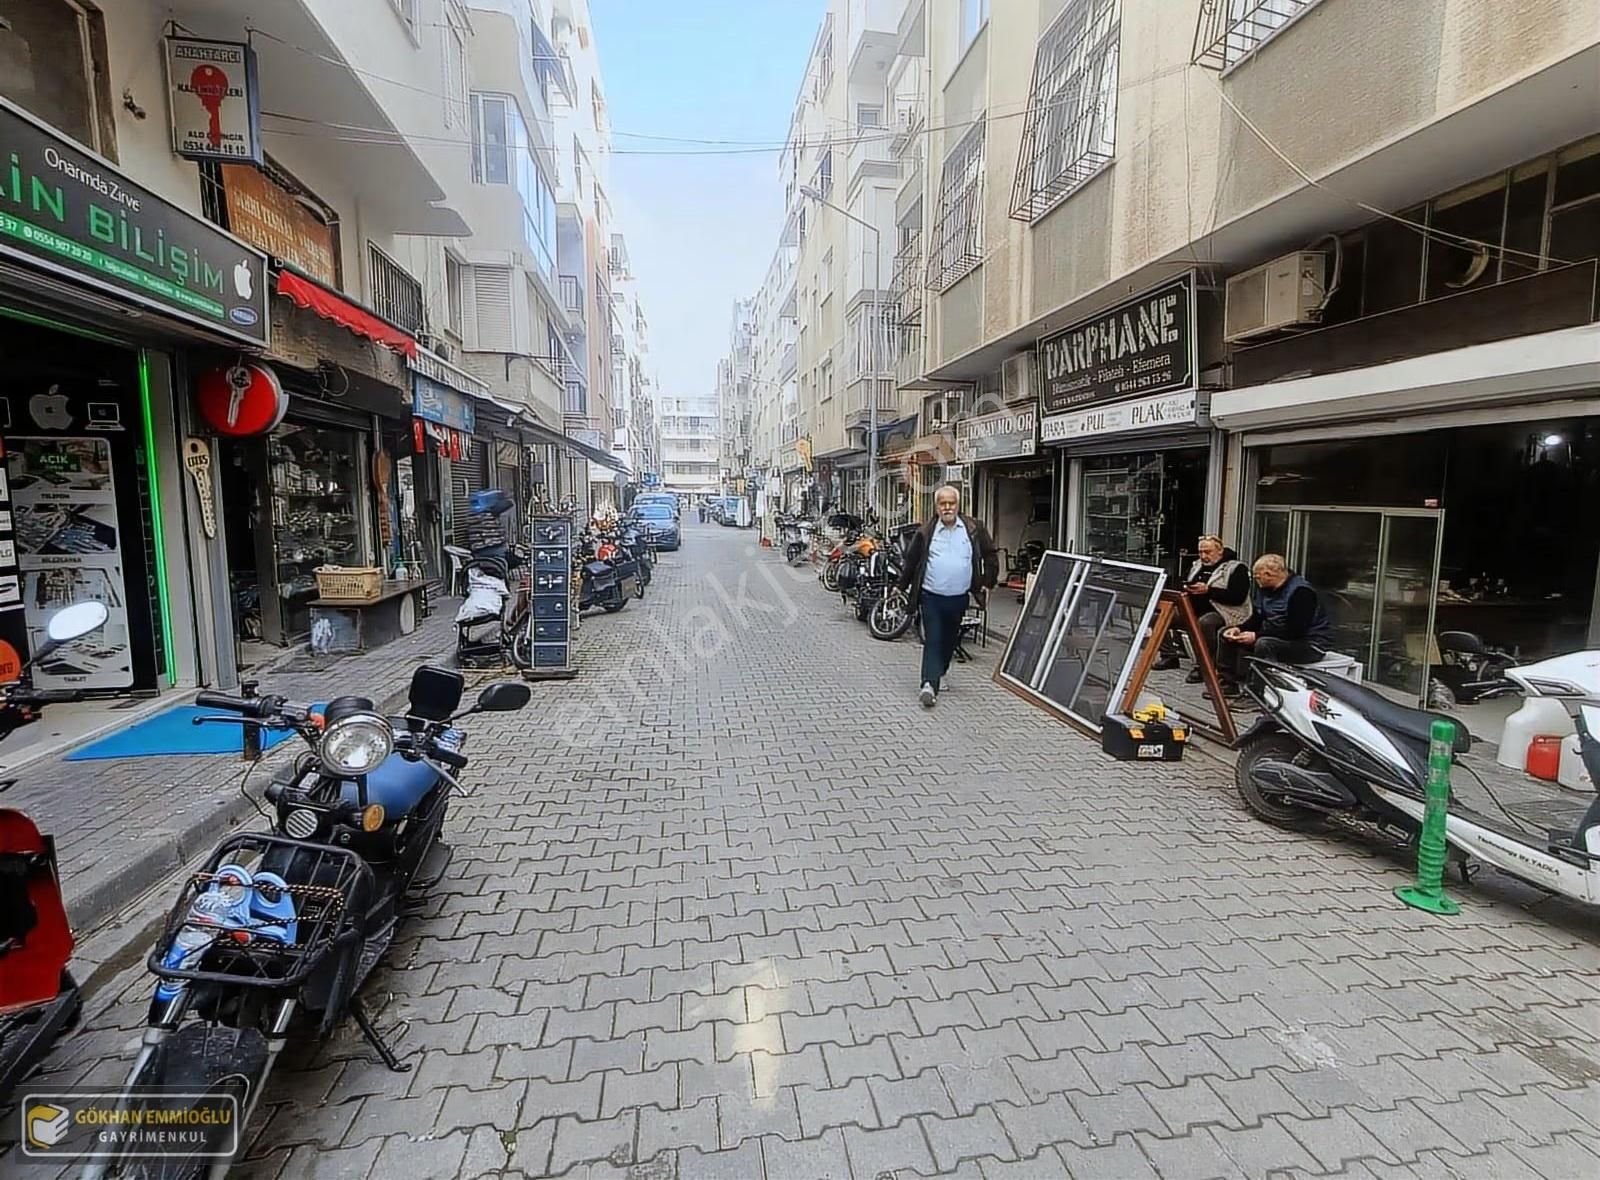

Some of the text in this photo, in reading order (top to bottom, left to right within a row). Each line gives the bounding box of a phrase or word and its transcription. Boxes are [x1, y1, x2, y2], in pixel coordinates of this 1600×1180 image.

[109, 181, 140, 212] Zirve
[90, 203, 224, 295] BİLİŞİM
[1046, 294, 1178, 380] DARPHANE
[1131, 401, 1165, 425] PLAK
